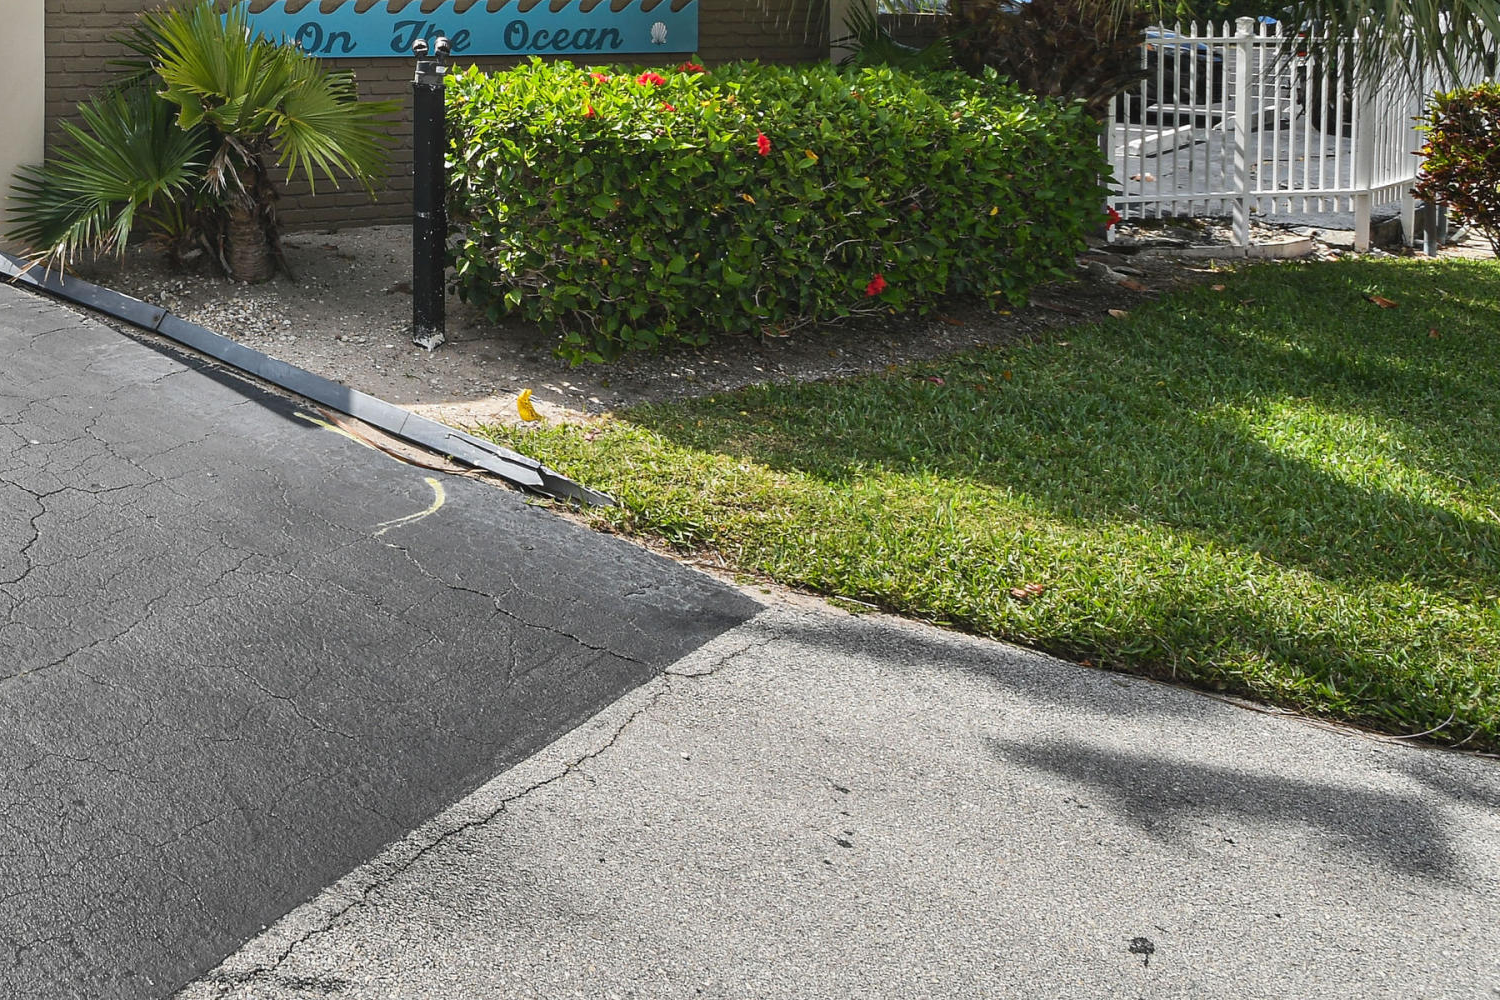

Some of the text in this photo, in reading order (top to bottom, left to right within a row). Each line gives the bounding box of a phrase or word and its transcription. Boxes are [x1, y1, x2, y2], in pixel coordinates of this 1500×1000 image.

[295, 19, 624, 54] On The Ocean
